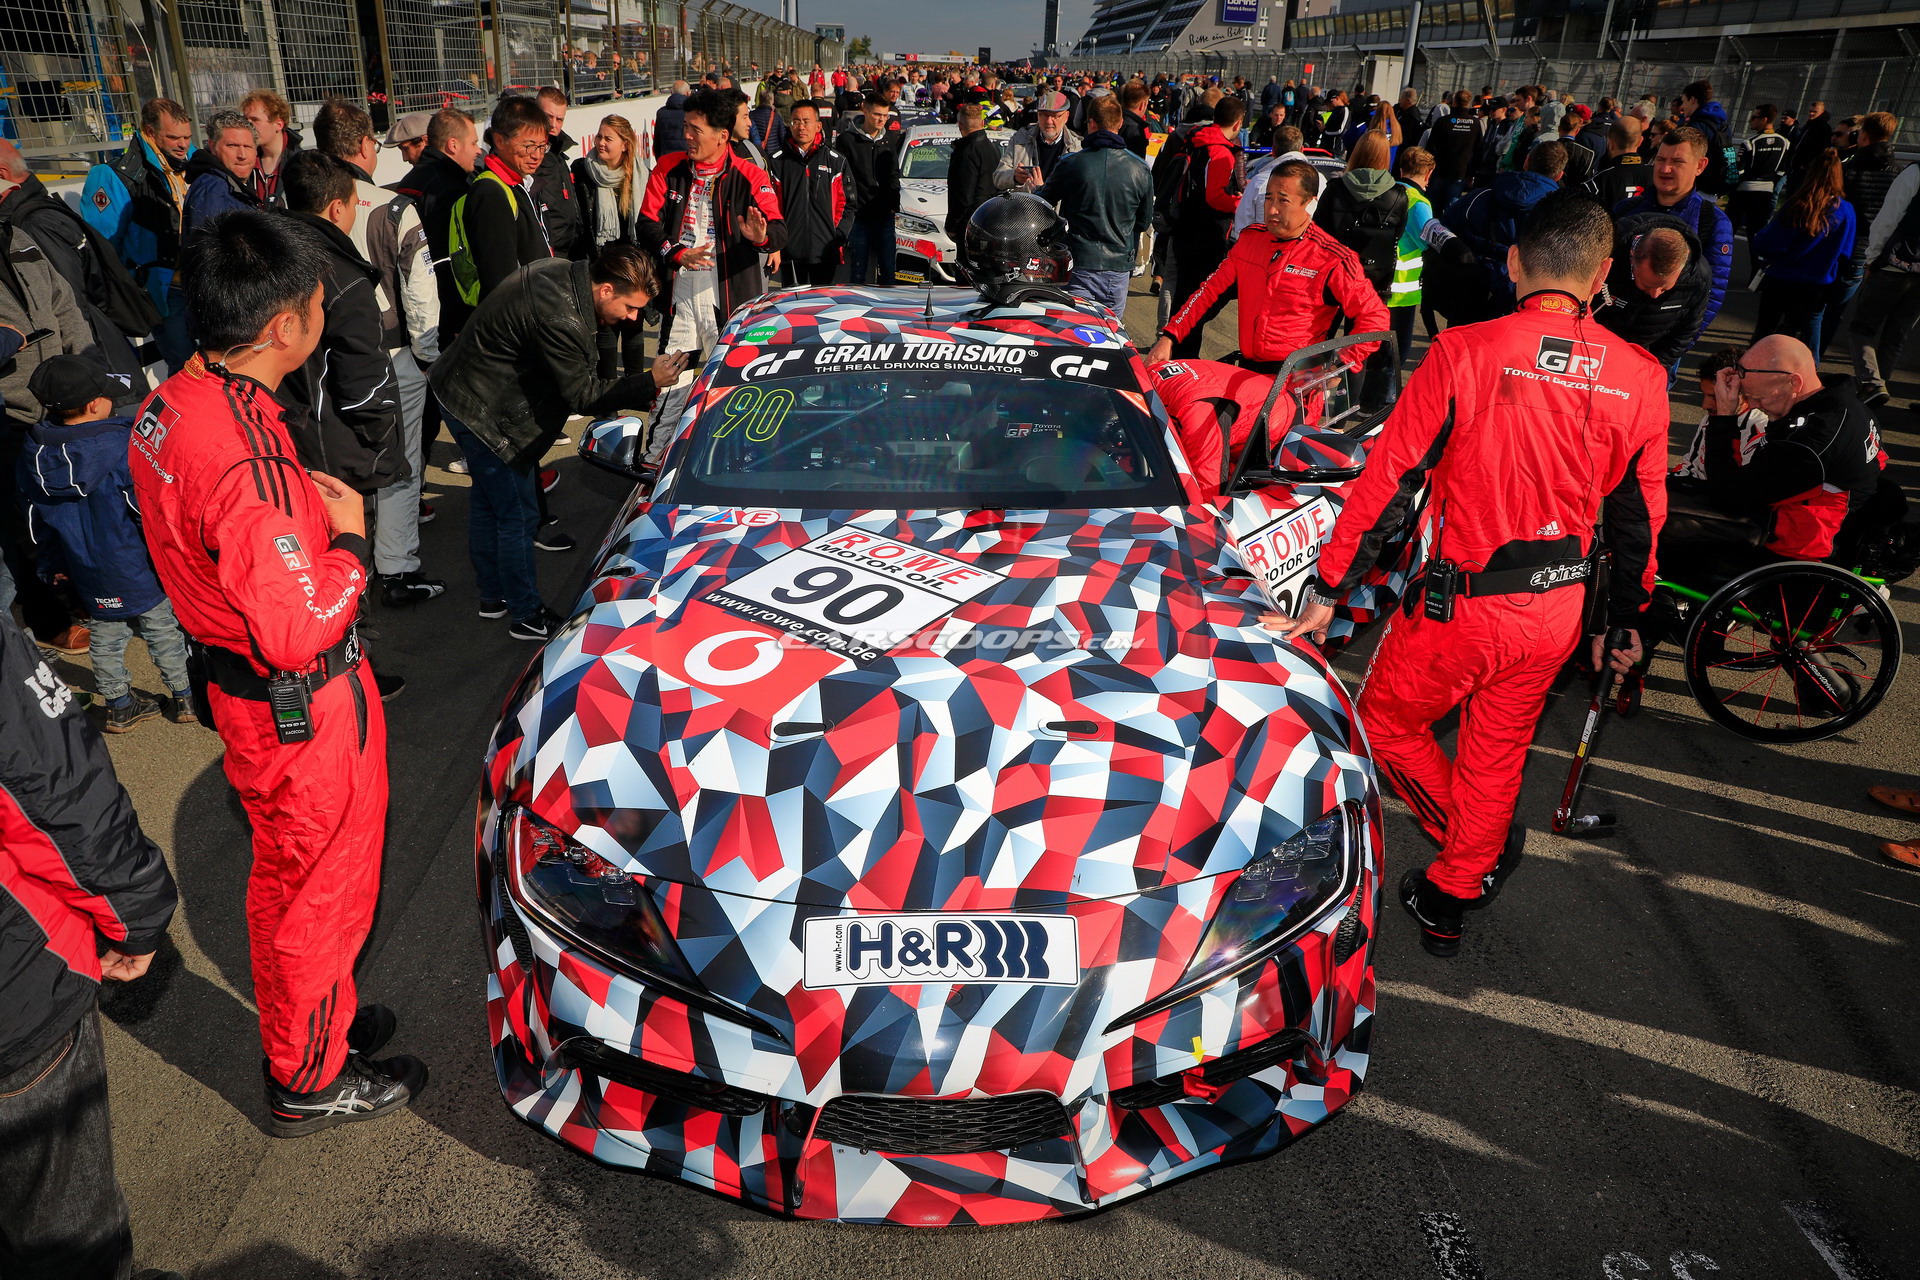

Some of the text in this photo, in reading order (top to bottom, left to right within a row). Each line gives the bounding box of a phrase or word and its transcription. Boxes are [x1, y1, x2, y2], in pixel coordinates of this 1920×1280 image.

[1084, 329, 1097, 342] T
[814, 343, 895, 365] GRAN
[815, 365, 841, 373] THE
[845, 363, 880, 371] REAL
[944, 362, 1023, 374] SIMULATOR
[1539, 350, 1601, 378] GR
[1503, 367, 1550, 382] TOYOTA
[1594, 384, 1630, 400] Racing
[140, 411, 167, 450] GR
[712, 385, 795, 442] 90
[1006, 428, 1029, 437] GR
[749, 512, 770, 524] E
[276, 538, 301, 568] GR
[1249, 508, 1326, 570] ROWE
[814, 544, 946, 591] MOTOR OIL
[829, 533, 982, 585] ROWE
[771, 566, 904, 625] 90
[704, 591, 878, 662] www.rowe.com.de
[24, 676, 48, 700] I
[833, 924, 843, 973] www.h-r.com
[849, 922, 976, 972] H&R
